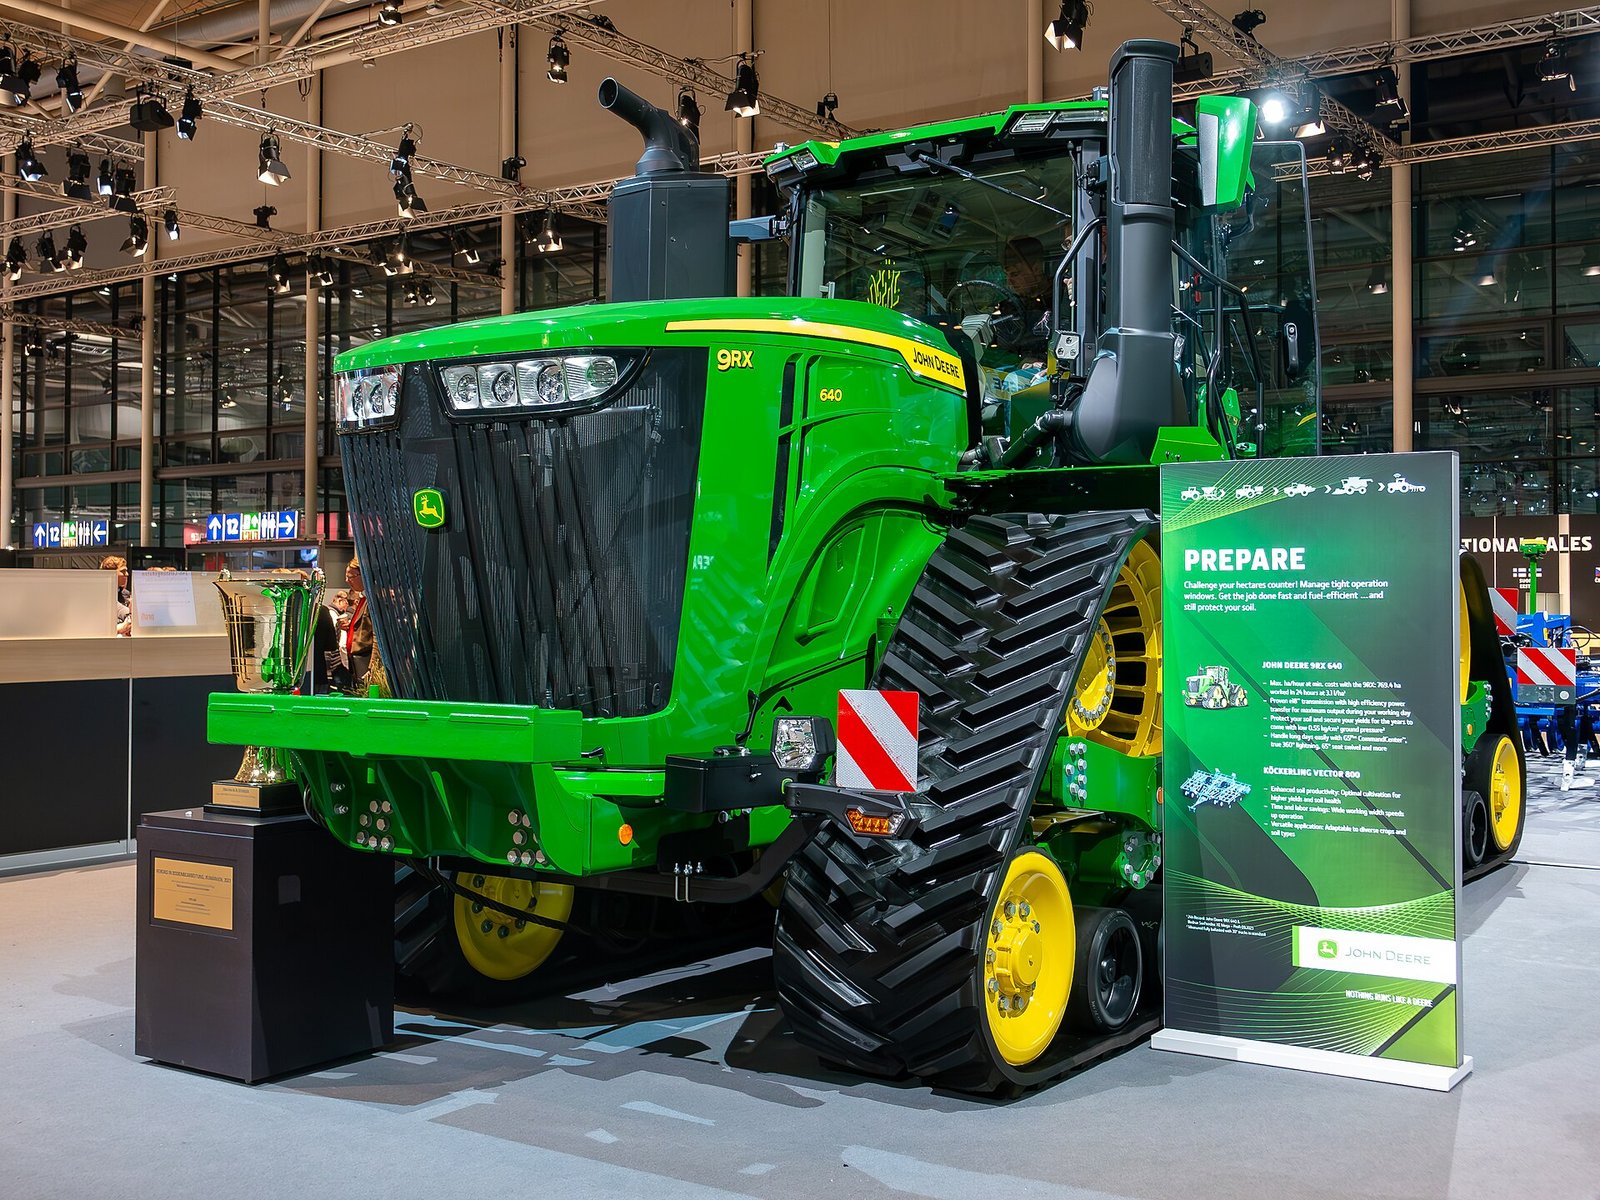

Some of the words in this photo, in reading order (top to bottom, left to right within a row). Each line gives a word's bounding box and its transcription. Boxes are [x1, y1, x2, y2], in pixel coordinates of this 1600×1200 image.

[717, 349, 755, 371] 9RX
[913, 347, 935, 369] JOHN
[934, 355, 960, 379] DEERE
[819, 389, 843, 402] 640
[49, 526, 60, 543] 12
[1536, 536, 1593, 552] ALES
[1184, 547, 1306, 572] PREPARE
[1183, 581, 1217, 591] Challenge
[1219, 582, 1235, 591] your
[1236, 581, 1266, 589] hectares
[1267, 581, 1298, 589] counter!
[1300, 580, 1330, 590] Manage
[1331, 580, 1350, 590] tight
[1351, 580, 1388, 589] operation
[1183, 592, 1217, 600] windows.
[1218, 592, 1231, 600] Get
[1232, 592, 1245, 600] the
[1245, 592, 1257, 602] job
[1258, 592, 1277, 600] done
[1278, 591, 1292, 600] fast
[1293, 591, 1307, 600] and
[1308, 591, 1359, 600] fuel-efficient
[1183, 603, 1197, 611] still
[1197, 603, 1224, 613] protect
[1224, 604, 1240, 613] your
[1241, 603, 1257, 611] soil.
[1262, 661, 1283, 669] JOHN
[1284, 661, 1310, 669] DEERE
[1310, 662, 1326, 670] 9RX
[1327, 662, 1343, 670] 640
[1301, 698, 1334, 706] transmission
[1348, 699, 1360, 708] high
[1361, 700, 1387, 708] efficiency
[1346, 708, 1363, 716] during
[1377, 709, 1400, 717] working
[1400, 710, 1412, 718] day
[1355, 717, 1371, 725] yields
[1289, 732, 1301, 741] long
[1314, 734, 1329, 742] easily
[1263, 766, 1312, 776] KÖCKERLING
[1312, 769, 1344, 778] VECTOR
[1345, 771, 1361, 779] 800
[1270, 785, 1295, 793] Enhanced
[1306, 788, 1339, 797] productivity:
[1340, 789, 1362, 797] Optimal
[1392, 791, 1402, 799] for
[1270, 794, 1287, 802] higher
[1287, 795, 1303, 803] yields
[1308, 806, 1330, 814] savings:
[1345, 808, 1368, 816] working
[1294, 822, 1325, 831] application:
[1325, 824, 1352, 832] Adaptable
[1281, 830, 1296, 838] types
[1345, 946, 1382, 960] JOHN
[1386, 950, 1432, 965] DEERE
[1345, 989, 1374, 1000] NOTHING
[1375, 992, 1392, 1002] RUNS
[1392, 994, 1406, 1004] LIKE
[1406, 997, 1412, 1005] A
[1412, 998, 1434, 1008] DEERE
